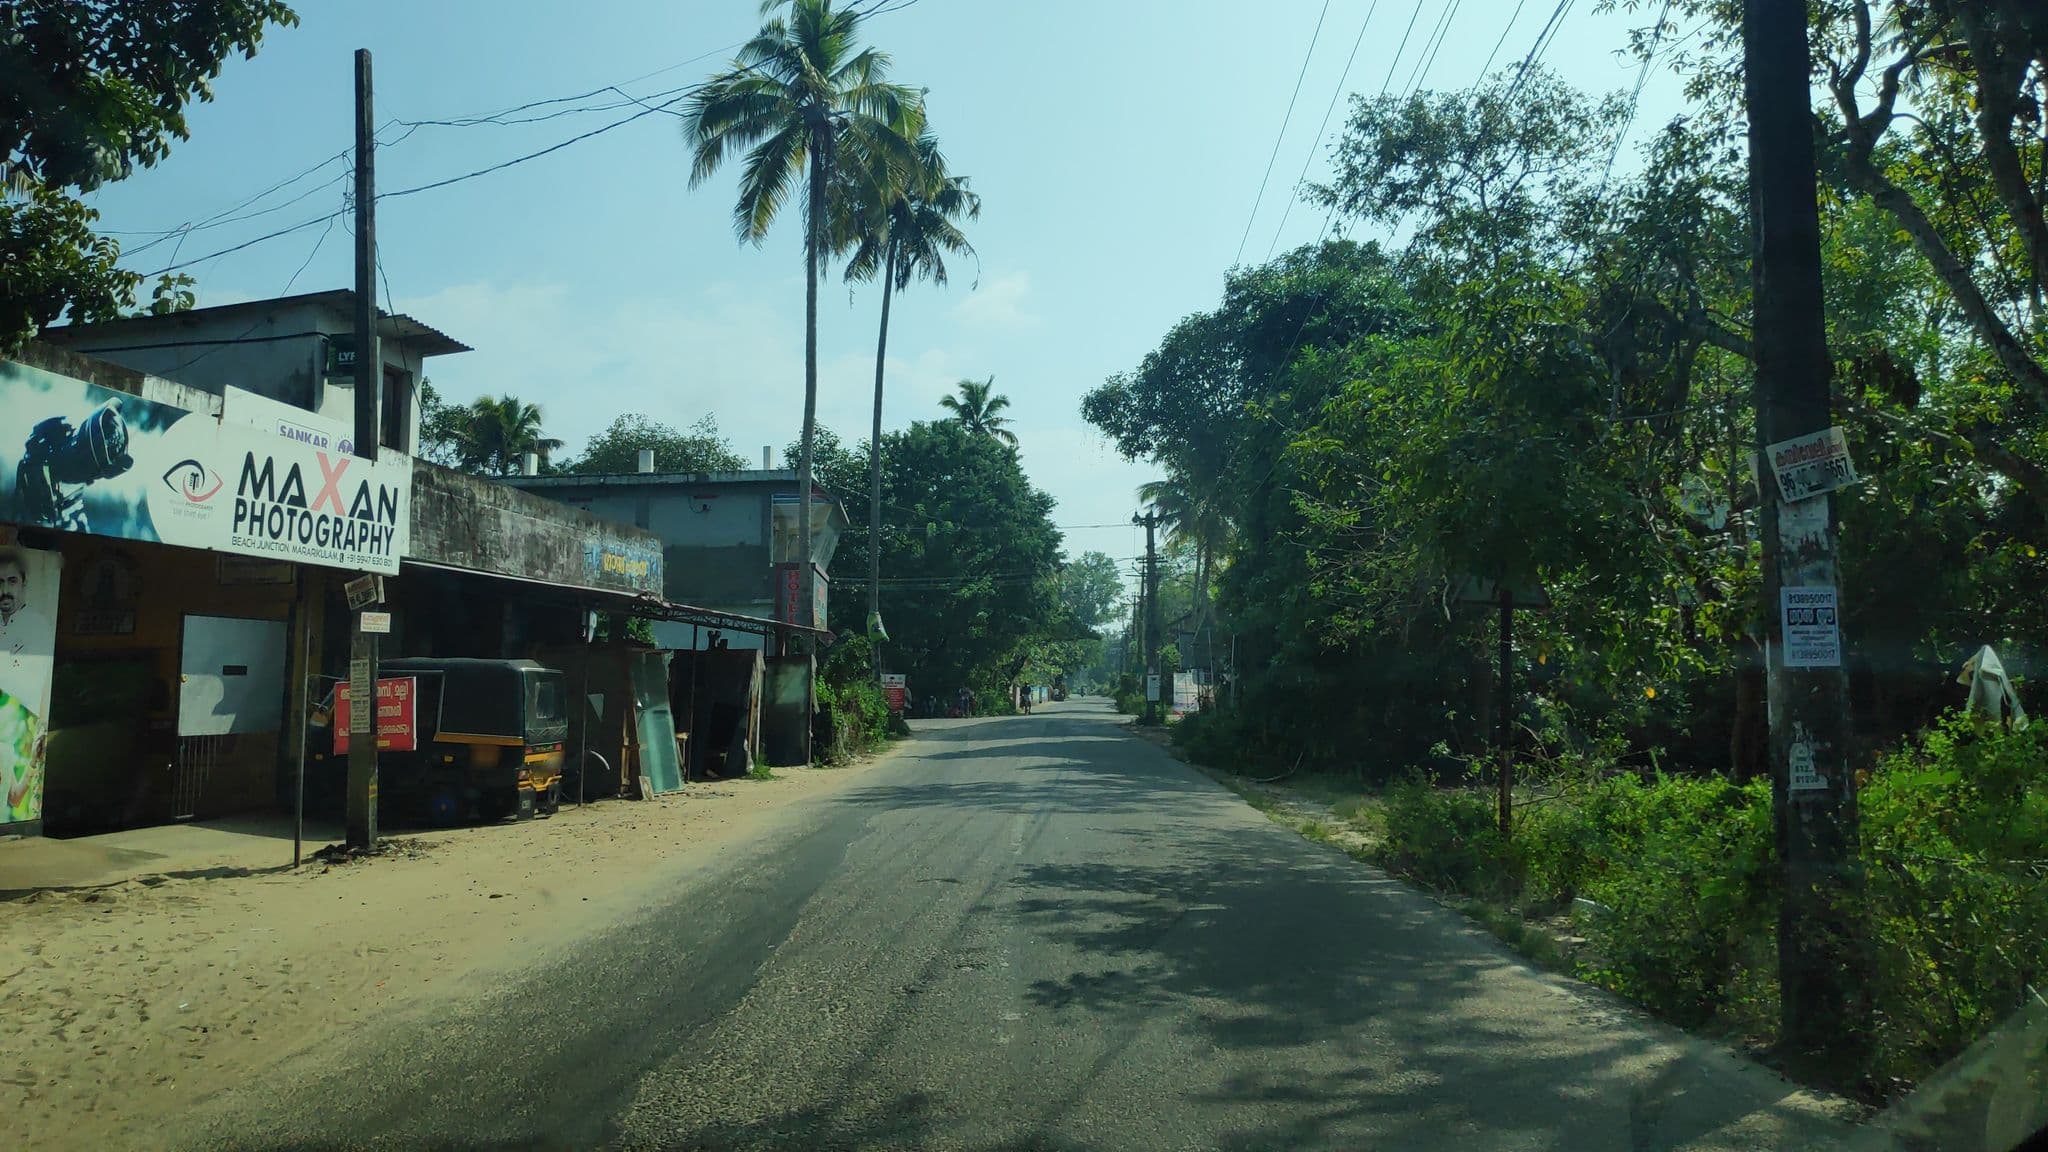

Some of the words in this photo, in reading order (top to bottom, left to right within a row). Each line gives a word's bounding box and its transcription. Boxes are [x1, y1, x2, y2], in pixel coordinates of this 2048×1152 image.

[280, 424, 329, 449] SANKAR
[237, 451, 398, 526] MAXAN
[232, 497, 394, 556] PHOTOGRAPHY
[232, 536, 256, 549] BEACH
